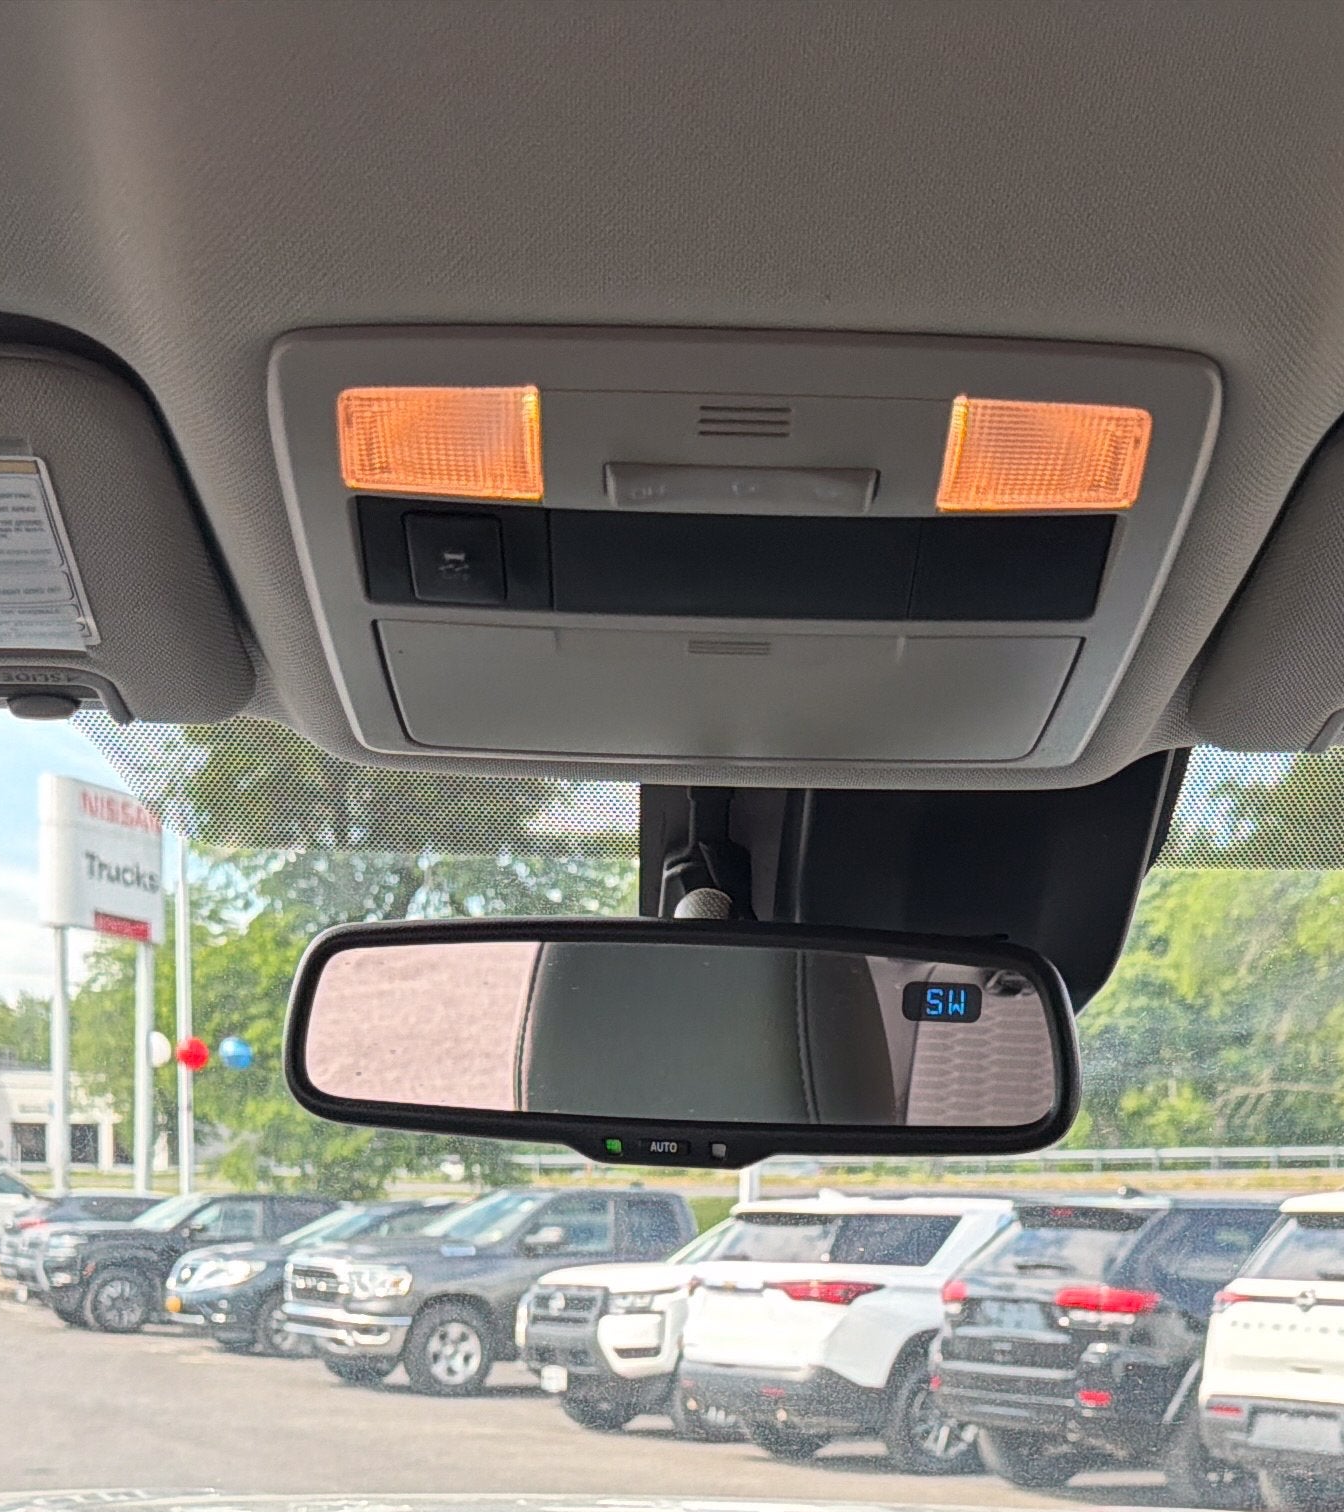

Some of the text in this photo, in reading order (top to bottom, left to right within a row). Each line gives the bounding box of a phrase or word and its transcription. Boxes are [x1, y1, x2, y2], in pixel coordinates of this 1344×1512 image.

[86, 852, 159, 893] Trucks
[926, 988, 966, 1015] SW
[650, 1142, 677, 1153] AUTO
